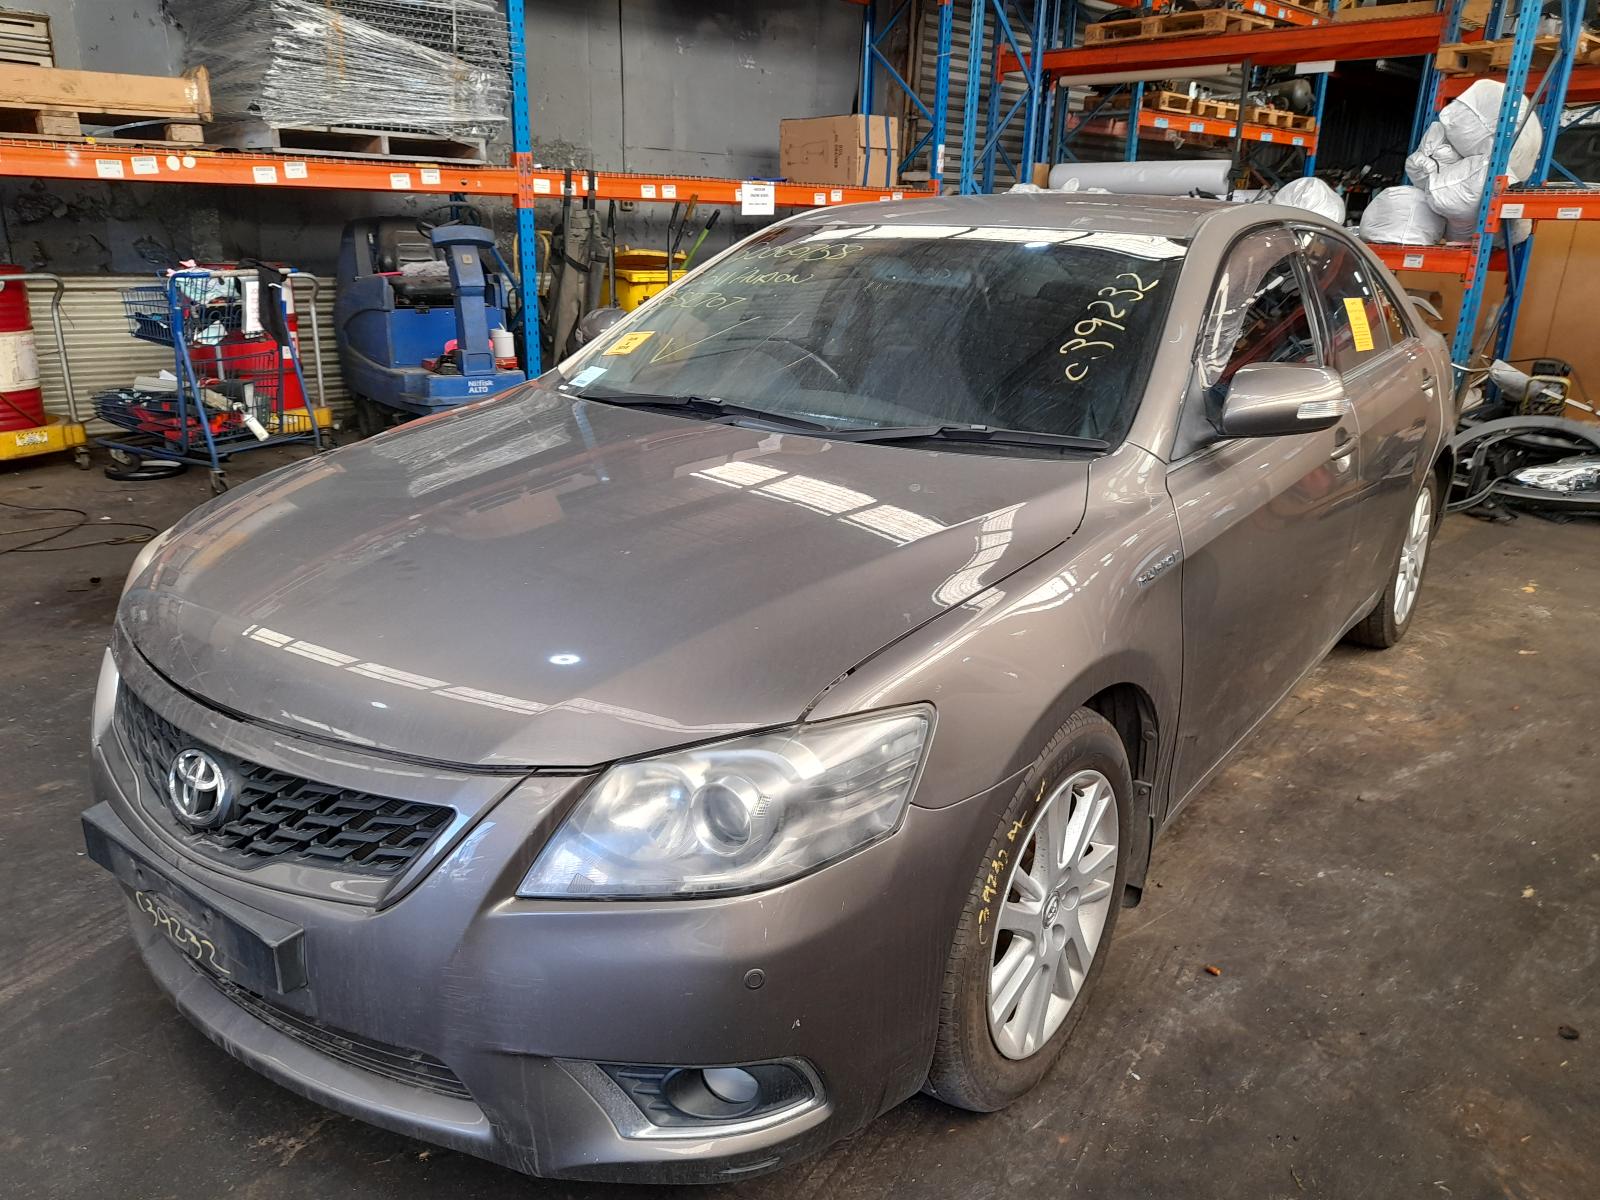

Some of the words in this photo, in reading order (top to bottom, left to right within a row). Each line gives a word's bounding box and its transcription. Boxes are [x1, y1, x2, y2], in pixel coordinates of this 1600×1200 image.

[1059, 272, 1160, 382] C39232
[467, 379, 494, 387] Nilfisk
[468, 386, 489, 394] ALTO
[135, 890, 231, 975] C39232
